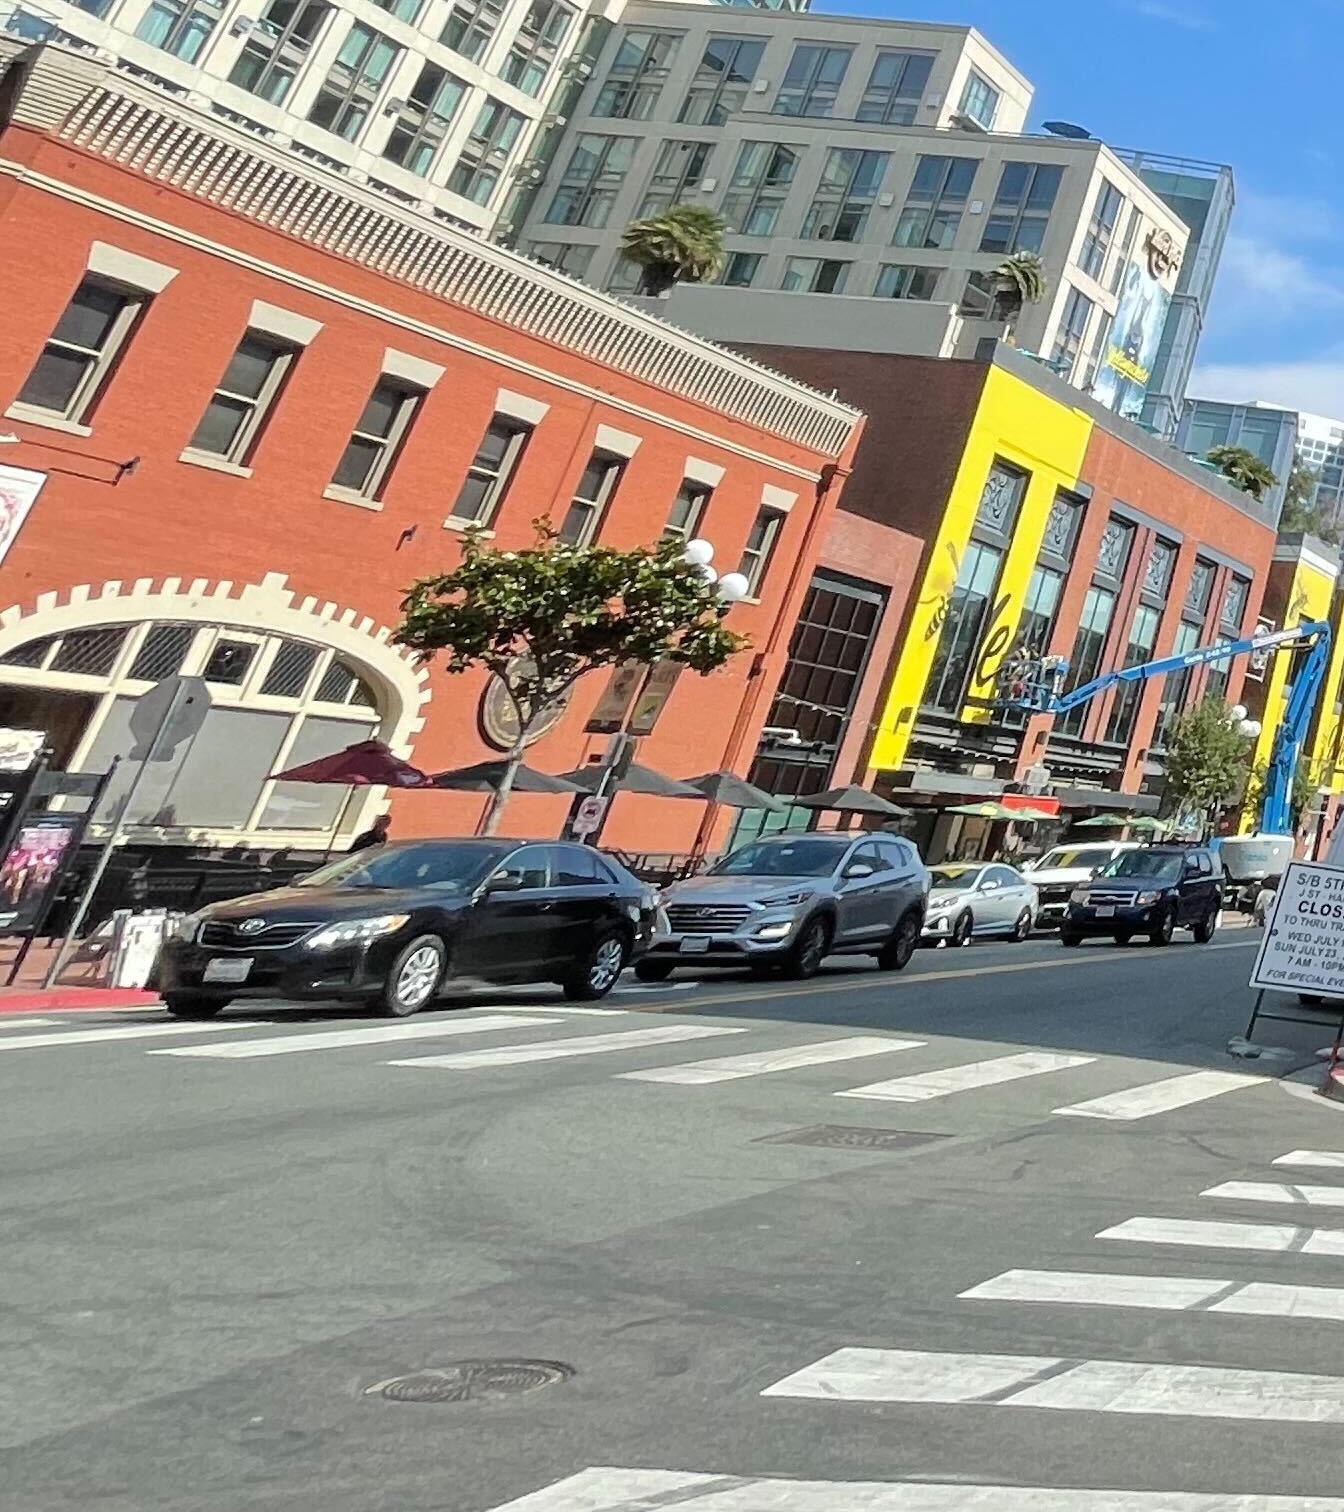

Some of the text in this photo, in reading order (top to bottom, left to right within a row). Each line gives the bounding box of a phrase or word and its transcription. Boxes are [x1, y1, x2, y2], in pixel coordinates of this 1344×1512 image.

[1296, 872, 1321, 888] S/B
[1298, 888, 1306, 898] J
[1308, 889, 1321, 900] ST
[1284, 914, 1298, 925] TO
[1300, 917, 1328, 930] THRU
[1287, 931, 1312, 943] WED
[1313, 934, 1339, 947] JULY
[1274, 941, 1296, 954] SUN
[1297, 944, 1324, 957] JULY
[1287, 955, 1294, 965] 7
[1295, 956, 1312, 968] AM
[1266, 968, 1286, 979] FOR
[1287, 970, 1325, 985] SPECIAL
